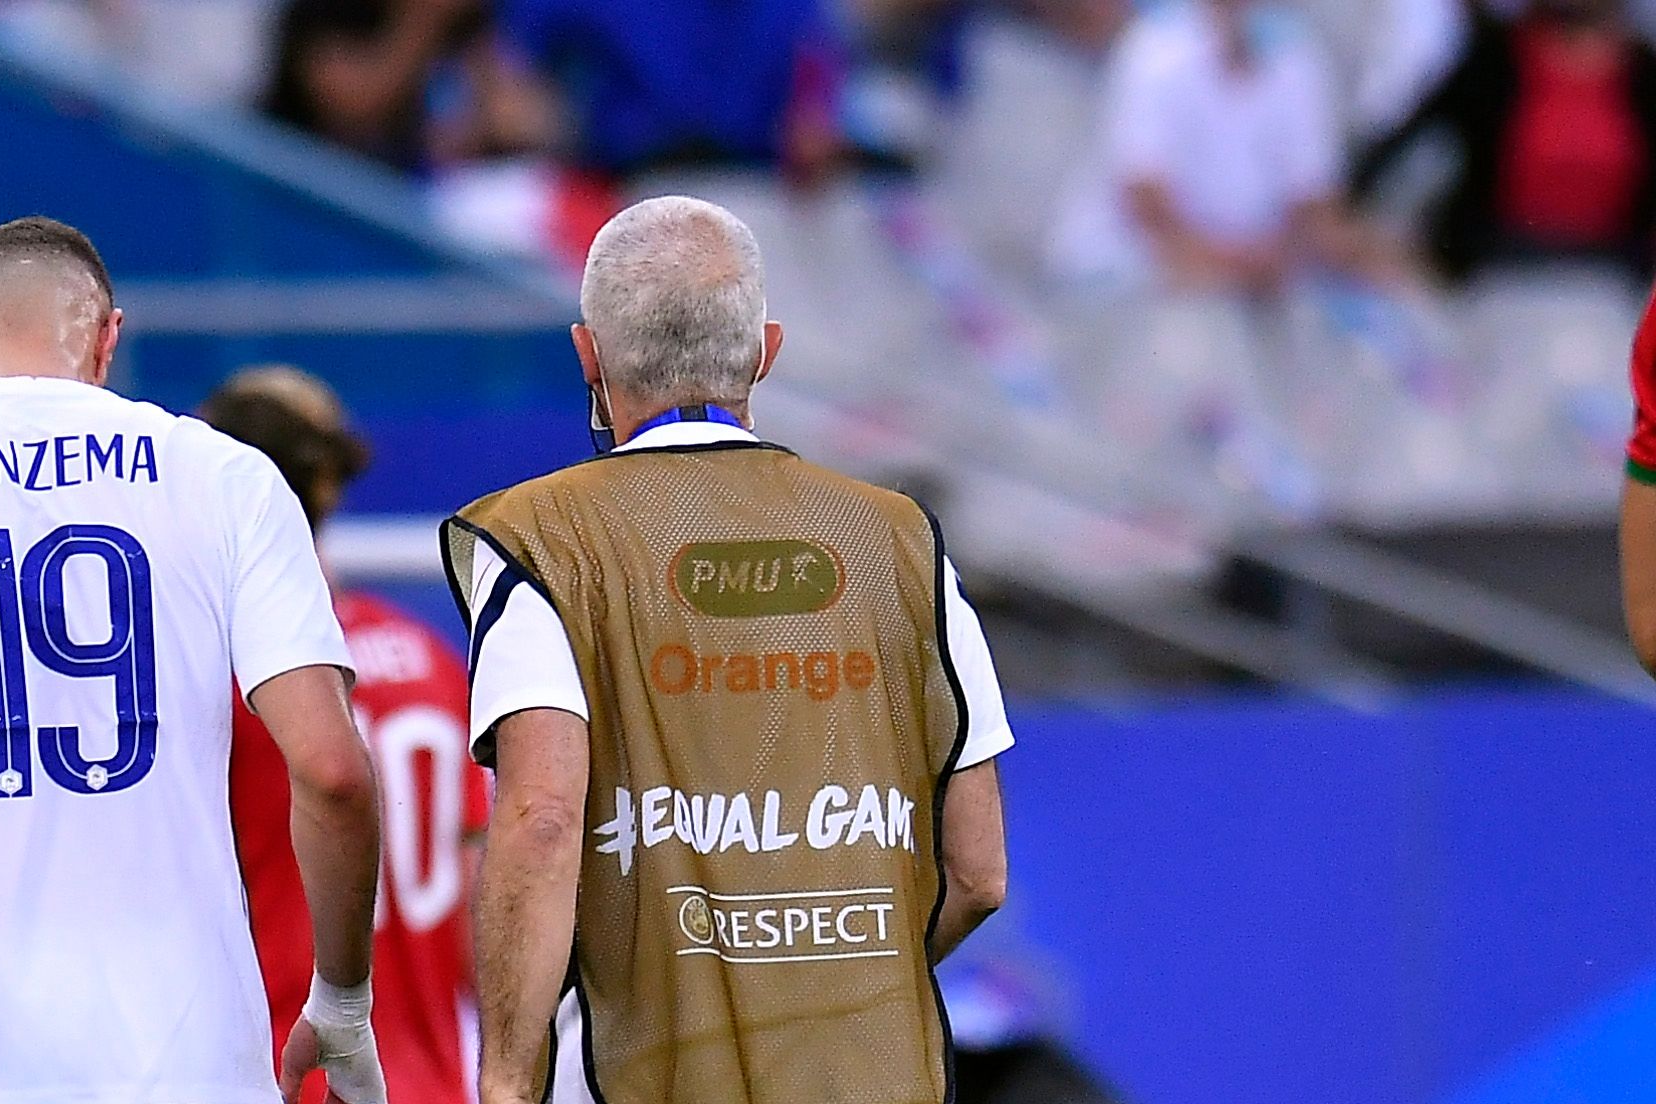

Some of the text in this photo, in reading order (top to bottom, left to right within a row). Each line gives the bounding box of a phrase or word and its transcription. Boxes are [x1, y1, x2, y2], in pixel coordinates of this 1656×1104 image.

[690, 557, 782, 594] PMU
[650, 642, 875, 702] Orange
[806, 784, 915, 855] GAM
[711, 903, 893, 949] RESPECT
